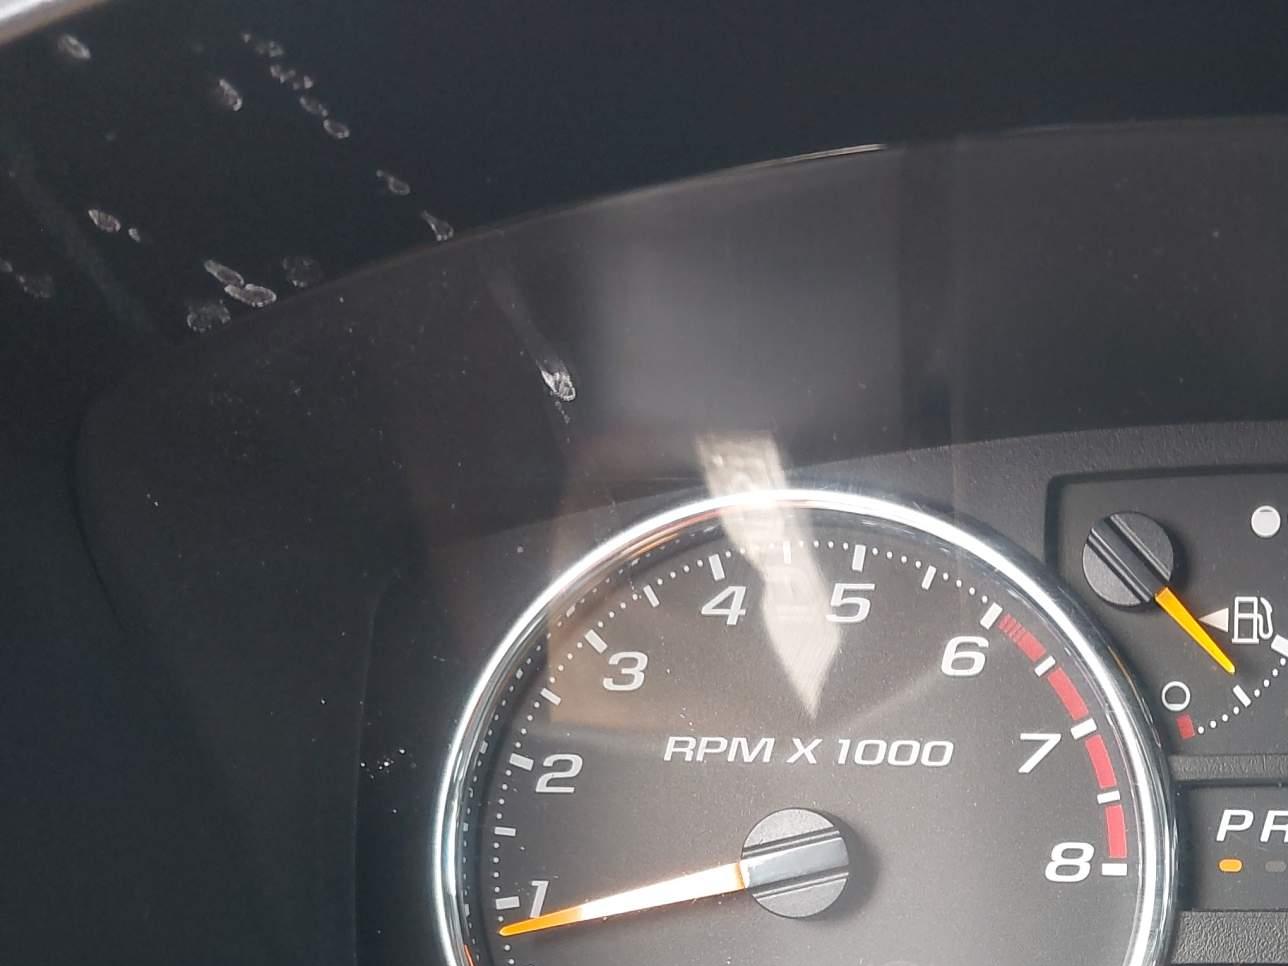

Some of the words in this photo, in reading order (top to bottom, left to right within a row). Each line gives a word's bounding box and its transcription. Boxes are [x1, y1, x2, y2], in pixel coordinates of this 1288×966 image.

[700, 586, 747, 626] 4
[826, 583, 875, 623] 5
[603, 651, 648, 691] 3
[941, 636, 989, 677] 6
[663, 736, 776, 763] RPM
[786, 737, 823, 764] X
[837, 738, 954, 766] 1000
[1018, 733, 1061, 773] 7
[535, 754, 583, 793] 2
[1045, 842, 1095, 882] 8
[529, 880, 549, 919] 1
